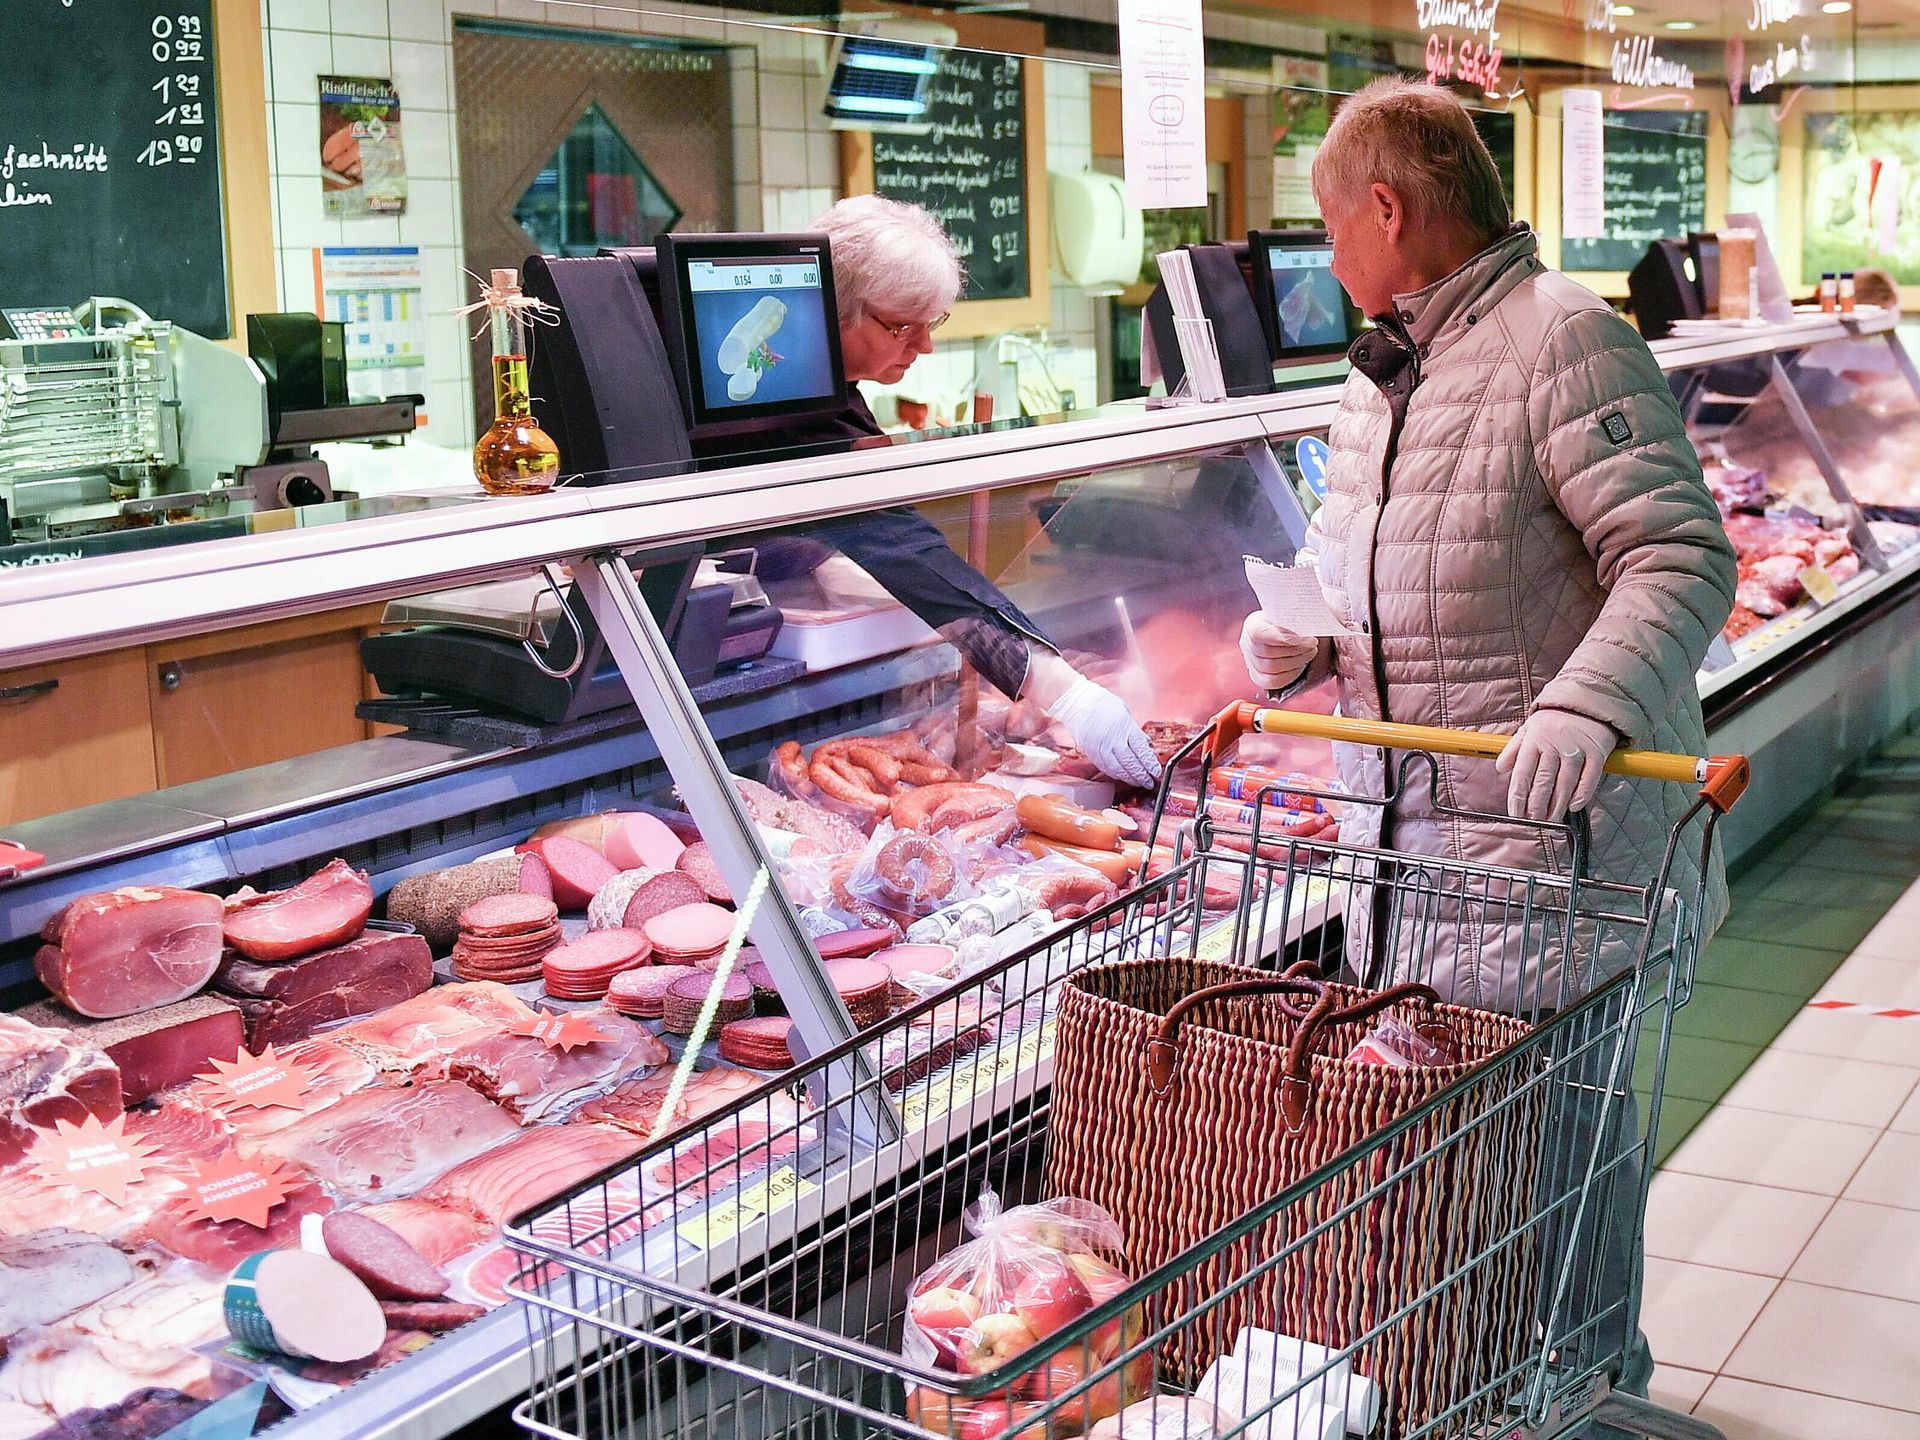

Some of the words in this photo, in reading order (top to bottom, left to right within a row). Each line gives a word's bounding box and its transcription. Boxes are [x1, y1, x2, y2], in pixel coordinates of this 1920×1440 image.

[234, 1071, 288, 1097] ANGEBOT
[197, 1171, 259, 1195] SONDER-
[203, 1178, 268, 1205] ANGEBOT
